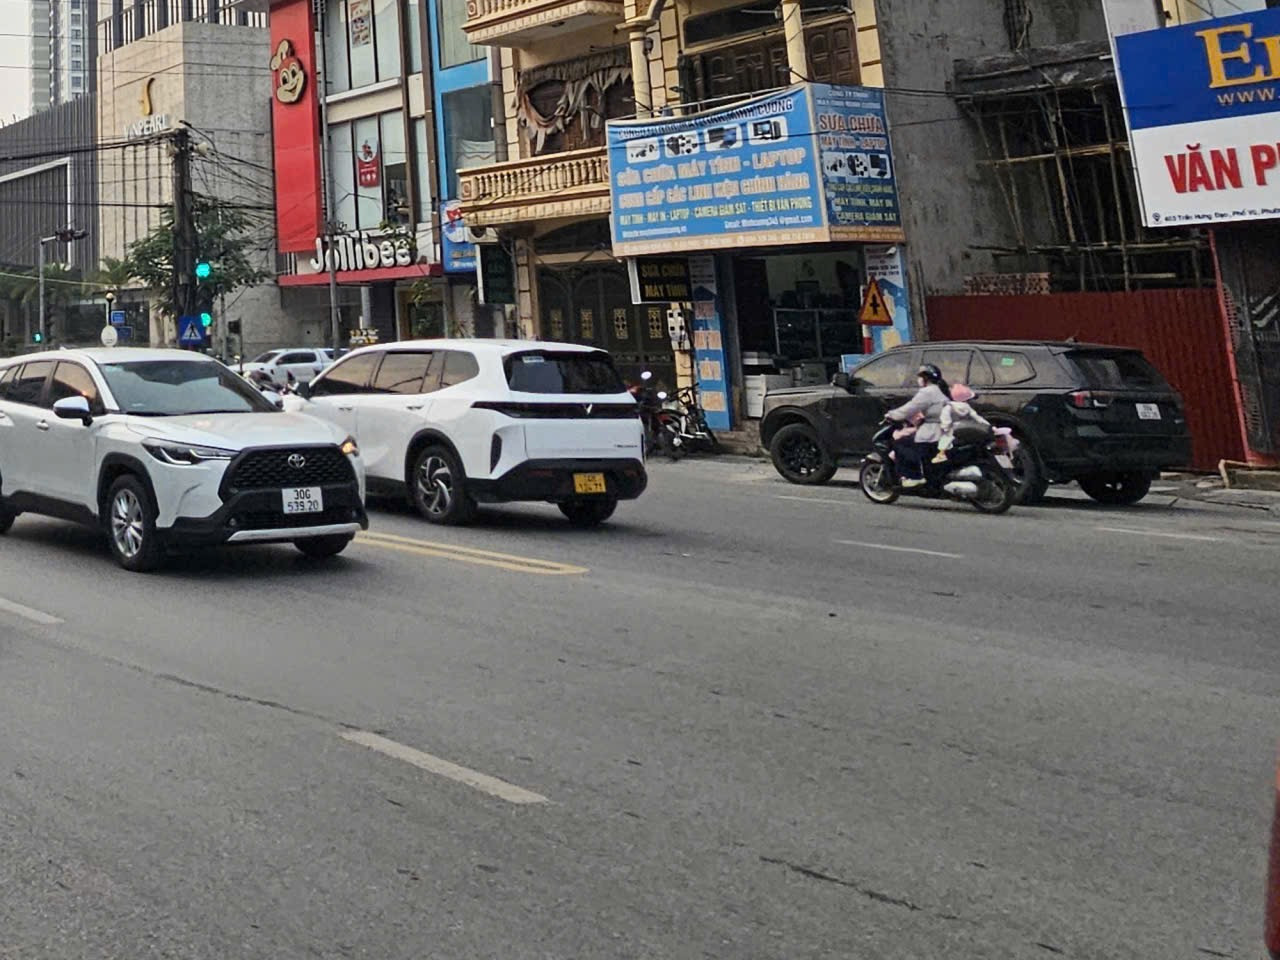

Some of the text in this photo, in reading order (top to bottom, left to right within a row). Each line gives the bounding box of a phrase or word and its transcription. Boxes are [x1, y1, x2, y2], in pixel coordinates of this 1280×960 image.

[819, 112, 885, 135] SỬA CHỮA
[677, 159, 706, 179] MÁY
[752, 147, 806, 170] LAPTOP
[1163, 142, 1280, 194] VĂN P
[310, 230, 411, 273] Jollibee
[293, 489, 311, 500] 30G
